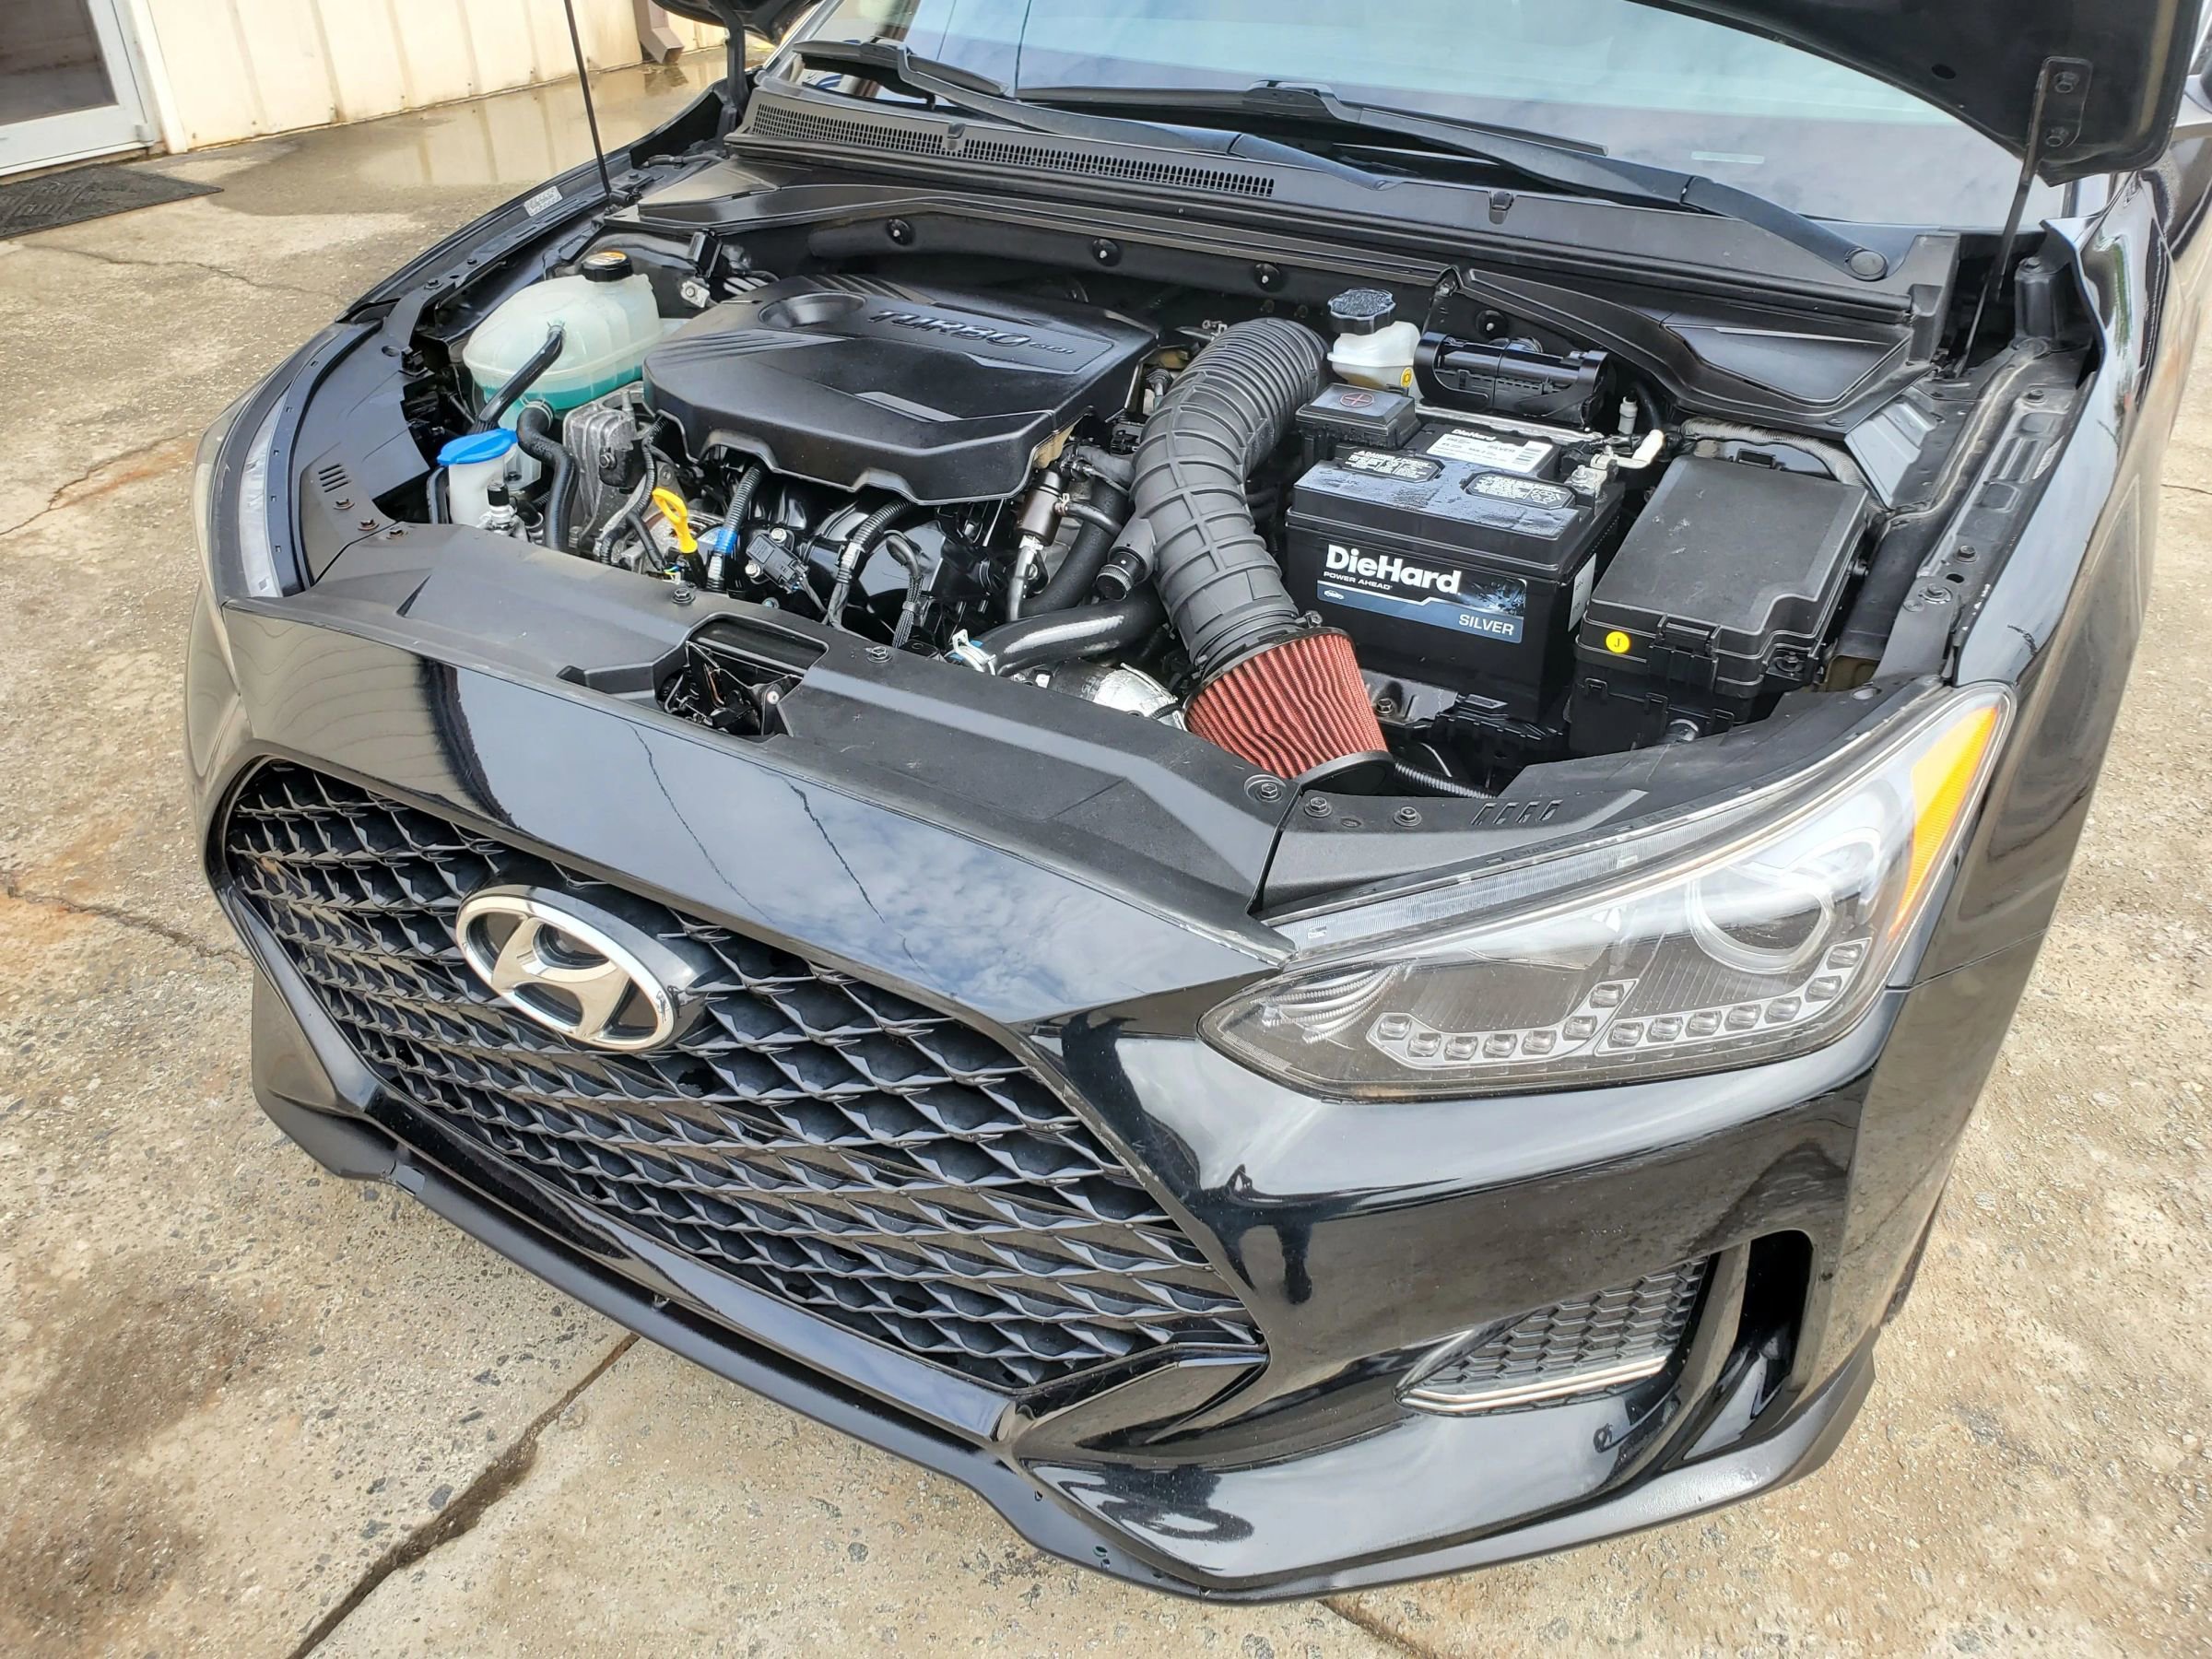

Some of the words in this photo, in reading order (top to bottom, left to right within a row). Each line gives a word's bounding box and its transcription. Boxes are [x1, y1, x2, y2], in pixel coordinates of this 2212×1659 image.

[867, 309, 1031, 347] TURBO
[1452, 429, 1497, 442] DieHard
[1325, 544, 1462, 594] DieHard
[1324, 571, 1356, 583] POWER
[1358, 579, 1392, 591] AHEAD
[1459, 614, 1514, 636] SILVER
[1614, 638, 1621, 648] J
